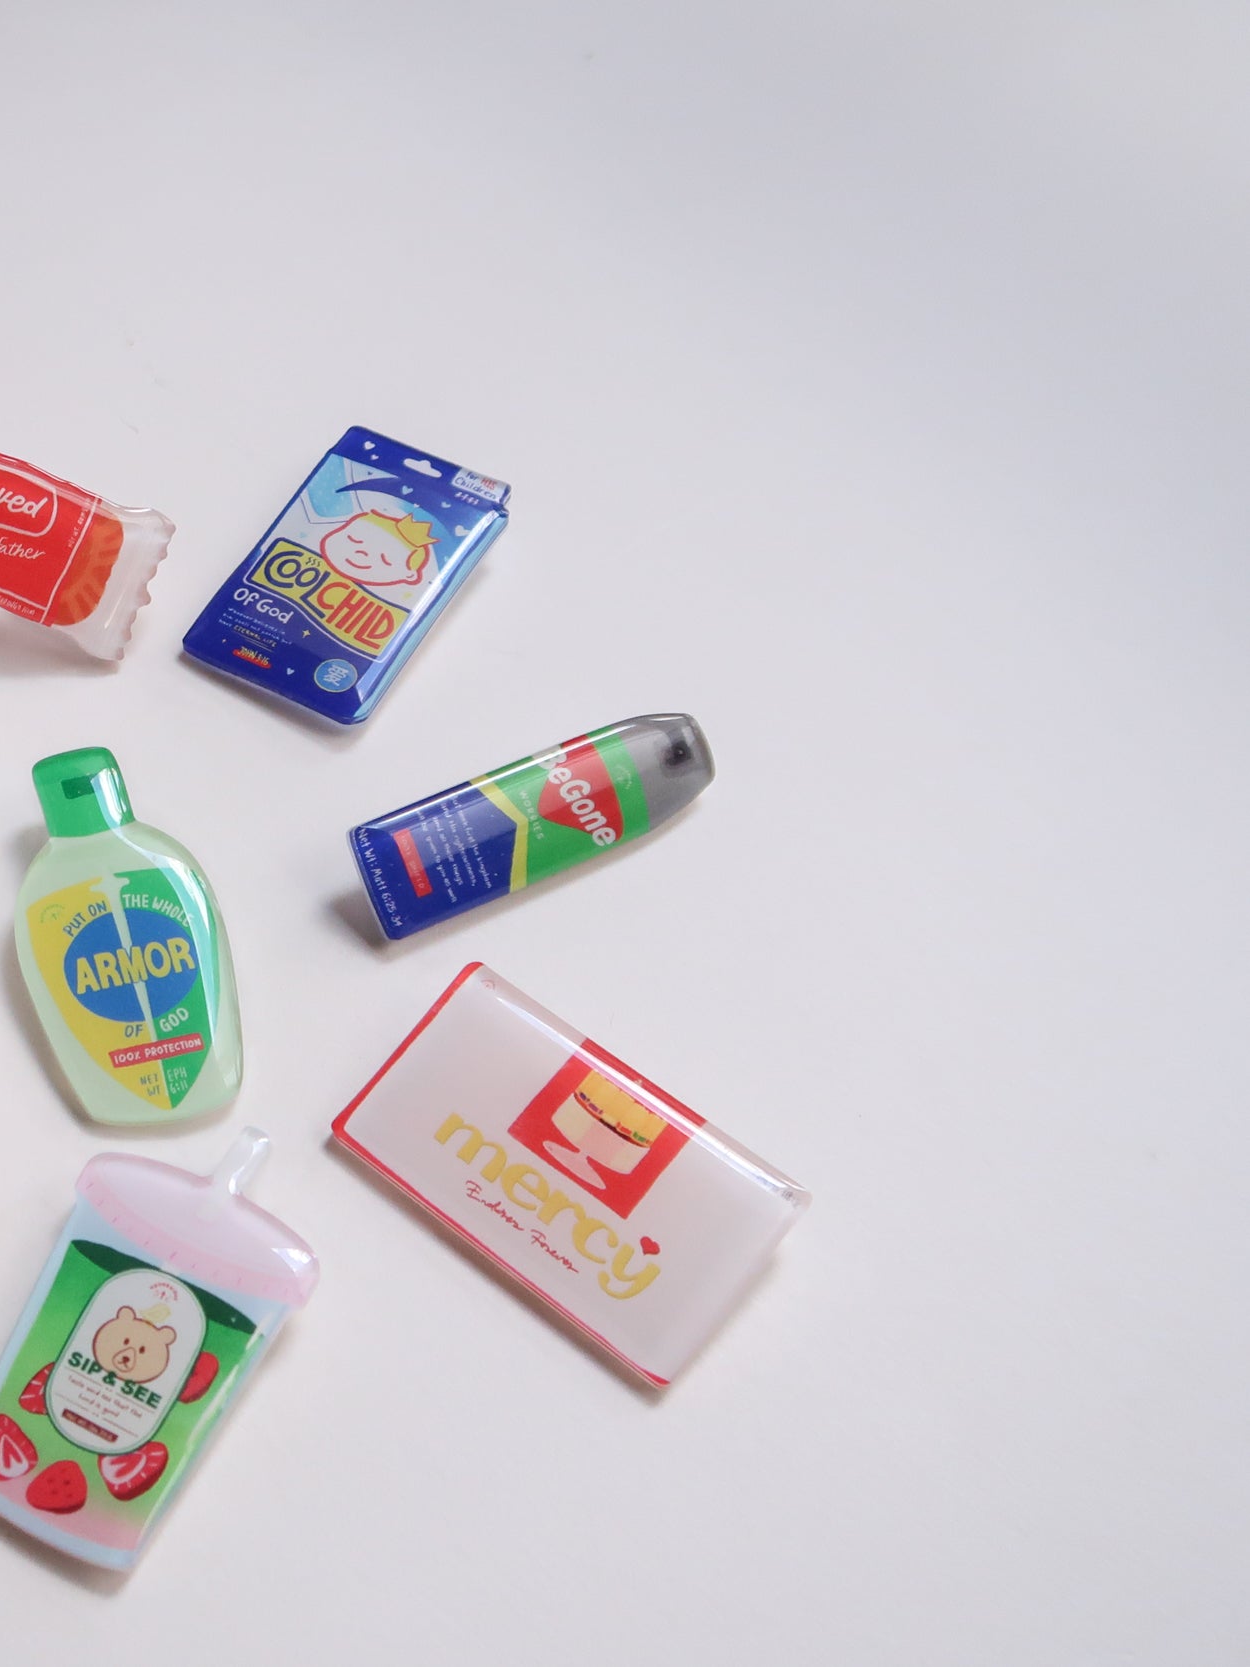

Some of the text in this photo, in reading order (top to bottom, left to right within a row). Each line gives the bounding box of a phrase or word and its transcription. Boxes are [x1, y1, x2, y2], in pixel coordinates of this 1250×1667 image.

[455, 476, 496, 500] Children
[256, 599, 294, 624] God
[316, 581, 396, 650] CHILD
[62, 912, 87, 938] PUT
[88, 900, 108, 917] ON
[122, 893, 149, 909] THE
[151, 896, 195, 928] WHOLE
[75, 936, 196, 995] ARMOR
[124, 1007, 190, 1038] OF GOD
[114, 1038, 202, 1065] 100% PROTECTION
[140, 1066, 187, 1085] NET EPH
[147, 1085, 161, 1097] WT
[433, 1112, 661, 1299] mercy
[466, 1180, 525, 1232] Endures
[68, 1351, 162, 1409] SIP & SEE
